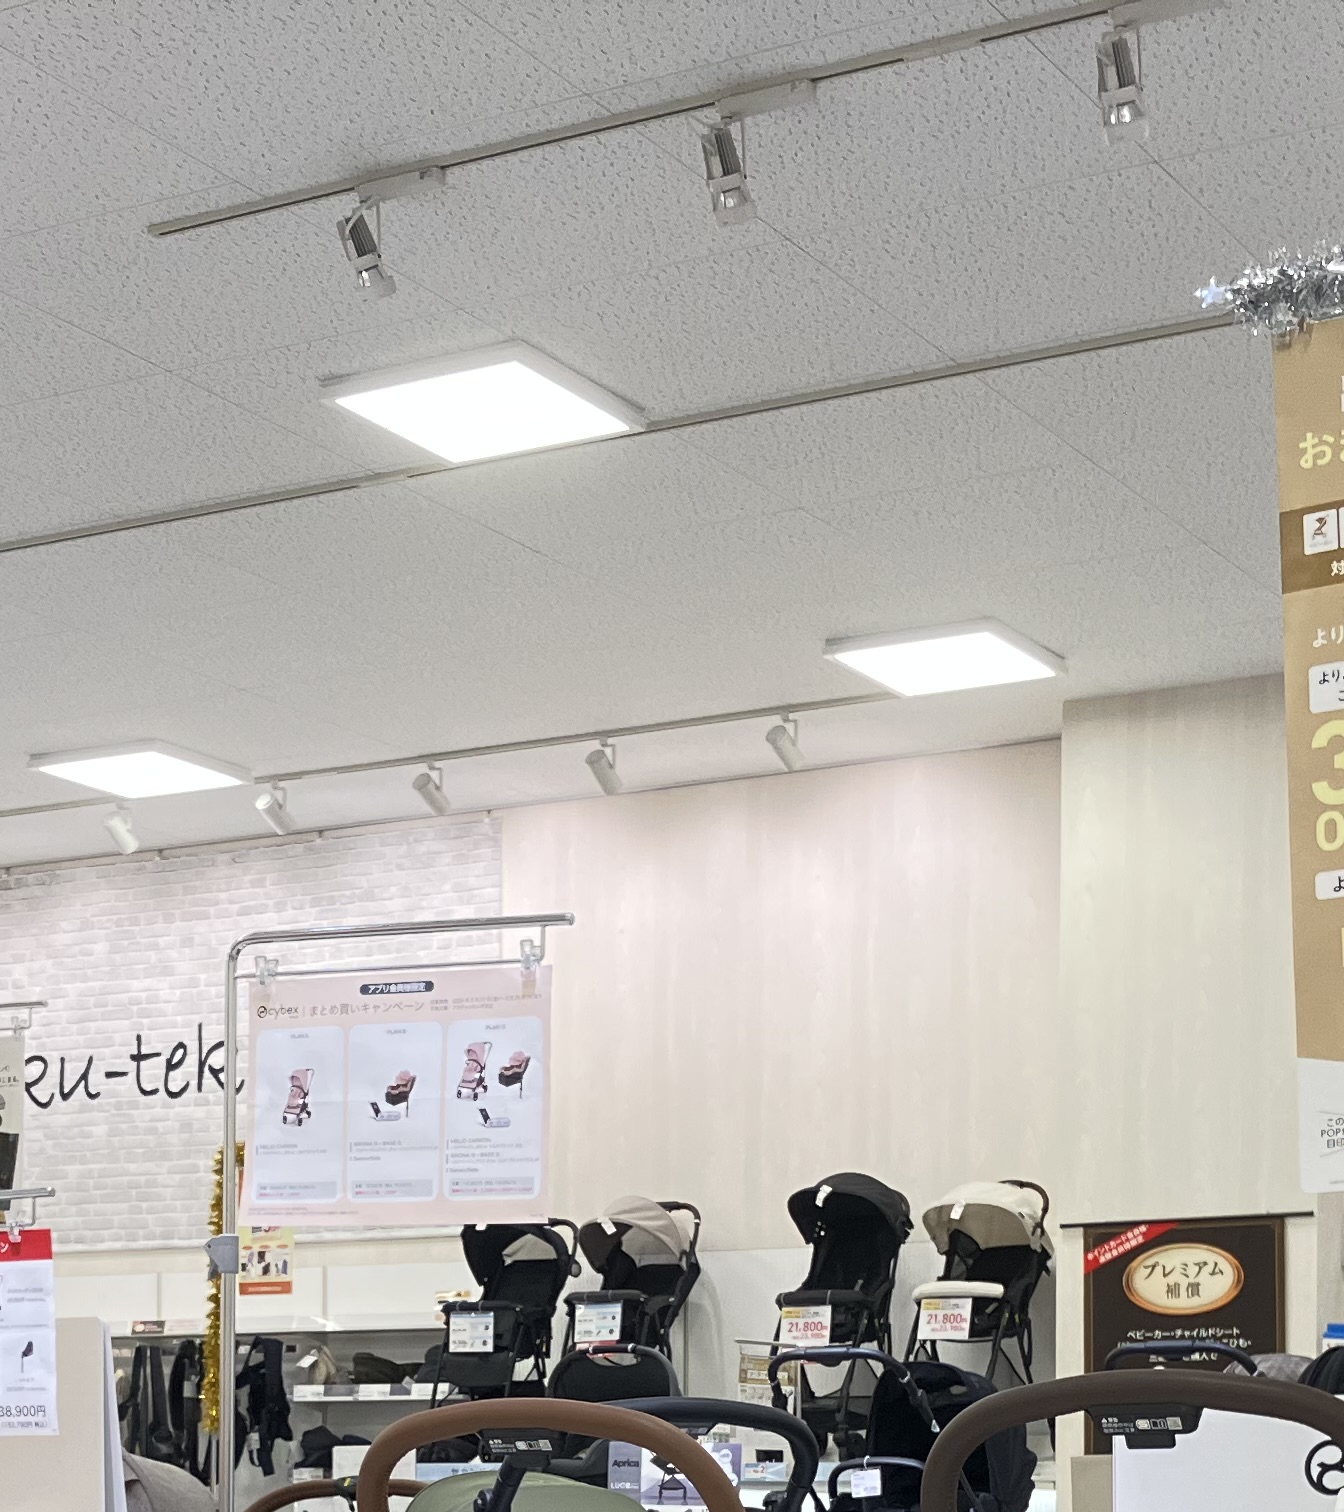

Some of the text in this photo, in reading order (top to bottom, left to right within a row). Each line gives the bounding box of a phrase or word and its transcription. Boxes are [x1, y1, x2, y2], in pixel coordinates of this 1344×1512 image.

[268, 1005, 299, 1021] cybex
[309, 1002, 424, 1016] まとめ買いキャンペーン
[1142, 1260, 1225, 1280] プレミアム
[1166, 1282, 1202, 1299] 補償
[926, 1313, 967, 1325] 21,800円
[787, 1321, 828, 1333] 21,800円
[1126, 1326, 1241, 1340] ベビーカー・チャイルドシート
[612, 1458, 639, 1469] Aprica
